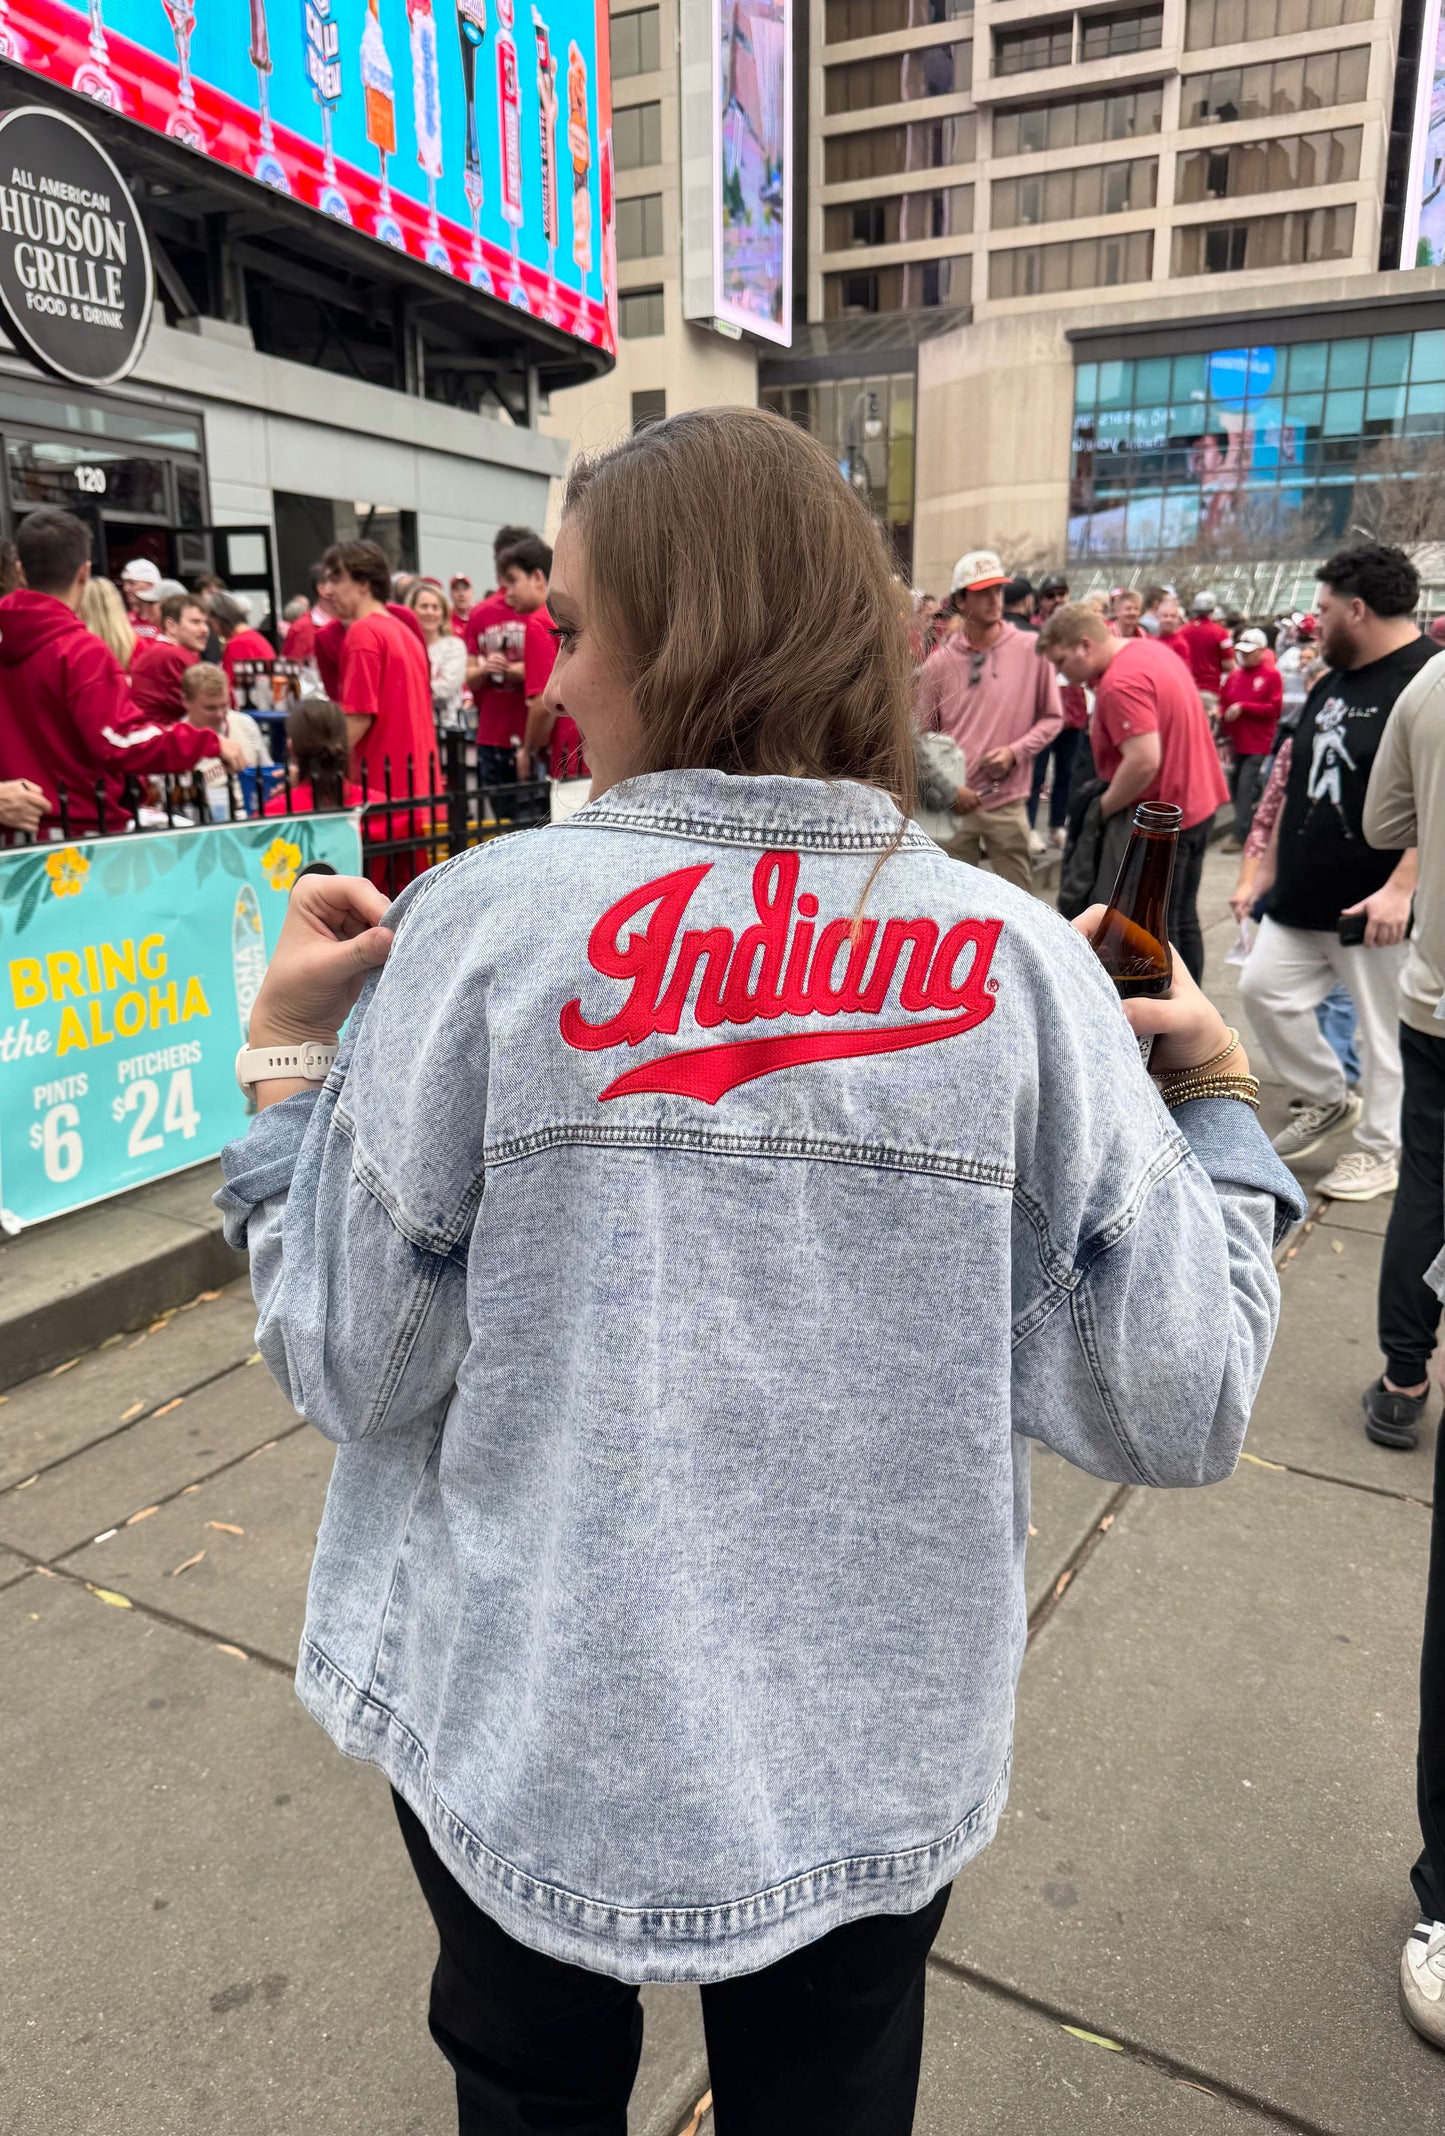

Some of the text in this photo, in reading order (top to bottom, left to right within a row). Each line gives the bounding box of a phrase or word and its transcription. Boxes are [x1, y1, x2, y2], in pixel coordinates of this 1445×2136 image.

[0, 185, 127, 266] HUDSON
[11, 167, 111, 213] ALL AMERICAN
[14, 242, 125, 310] GRILLE
[26, 291, 124, 330] FOOD & DRINK
[74, 465, 106, 493] 120
[9, 934, 168, 1009] BRING
[559, 849, 1003, 1051] Indiana
[0, 976, 211, 1063] the ALOHA
[33, 1072, 89, 1110] PINTS
[117, 1040, 202, 1083] PITCHERS
[29, 1103, 84, 1182] $6
[112, 1069, 200, 1158] $24
